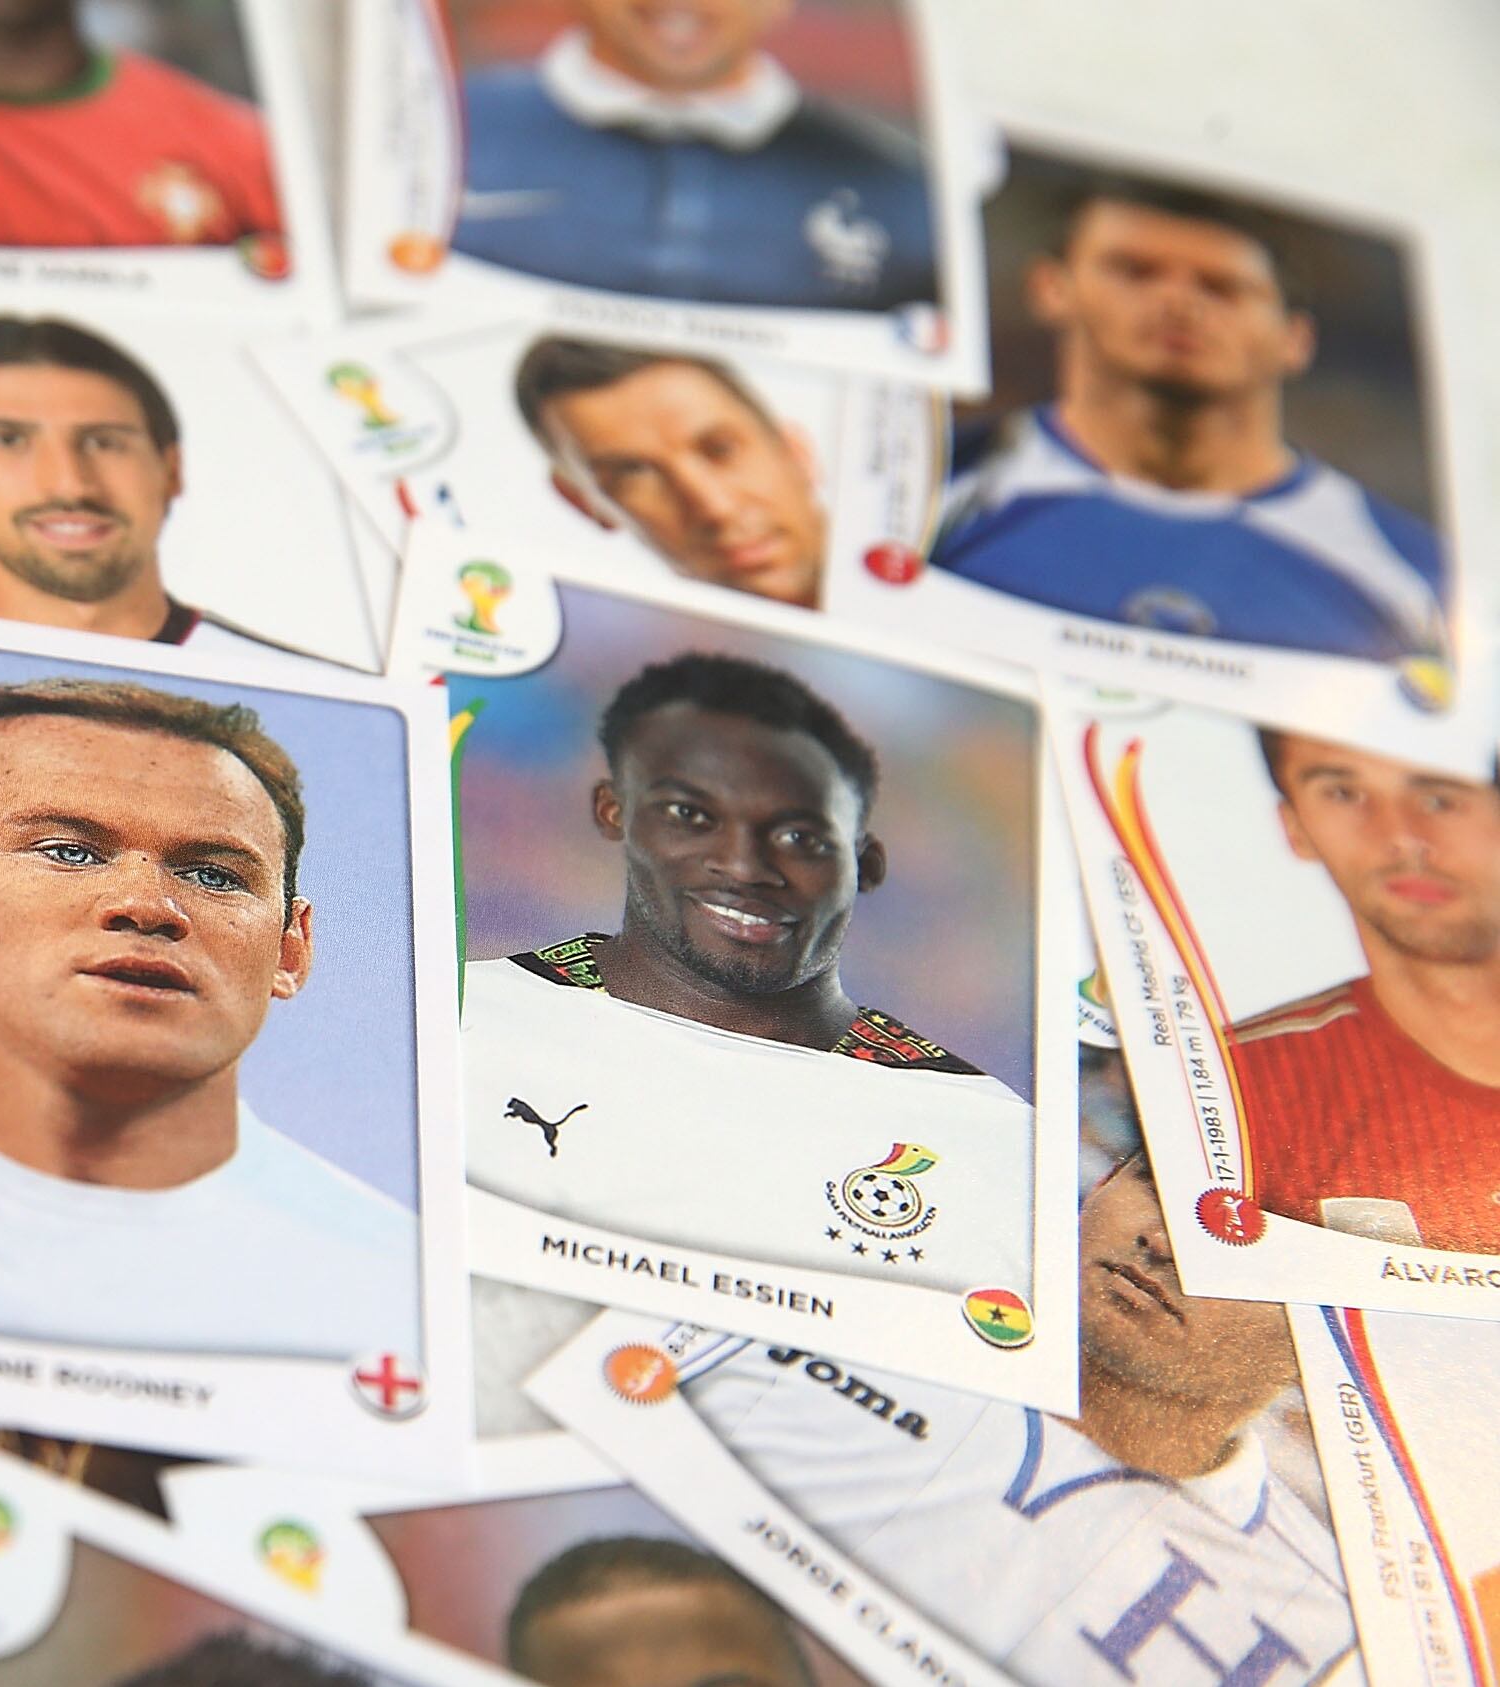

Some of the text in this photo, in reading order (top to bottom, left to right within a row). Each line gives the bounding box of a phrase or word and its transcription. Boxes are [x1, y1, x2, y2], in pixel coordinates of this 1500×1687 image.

[1131, 940, 1163, 1001] Madrid
[1147, 1006, 1173, 1046] Real
[1173, 974, 1237, 1182] 17-1-1983 1,84 m 79 kg
[542, 1233, 835, 1320] MICHAEL ESSIEN
[1337, 1381, 1363, 1445] (GER)
[1352, 1451, 1391, 1549] Frankfurt
[740, 1517, 853, 1601] JORGE
